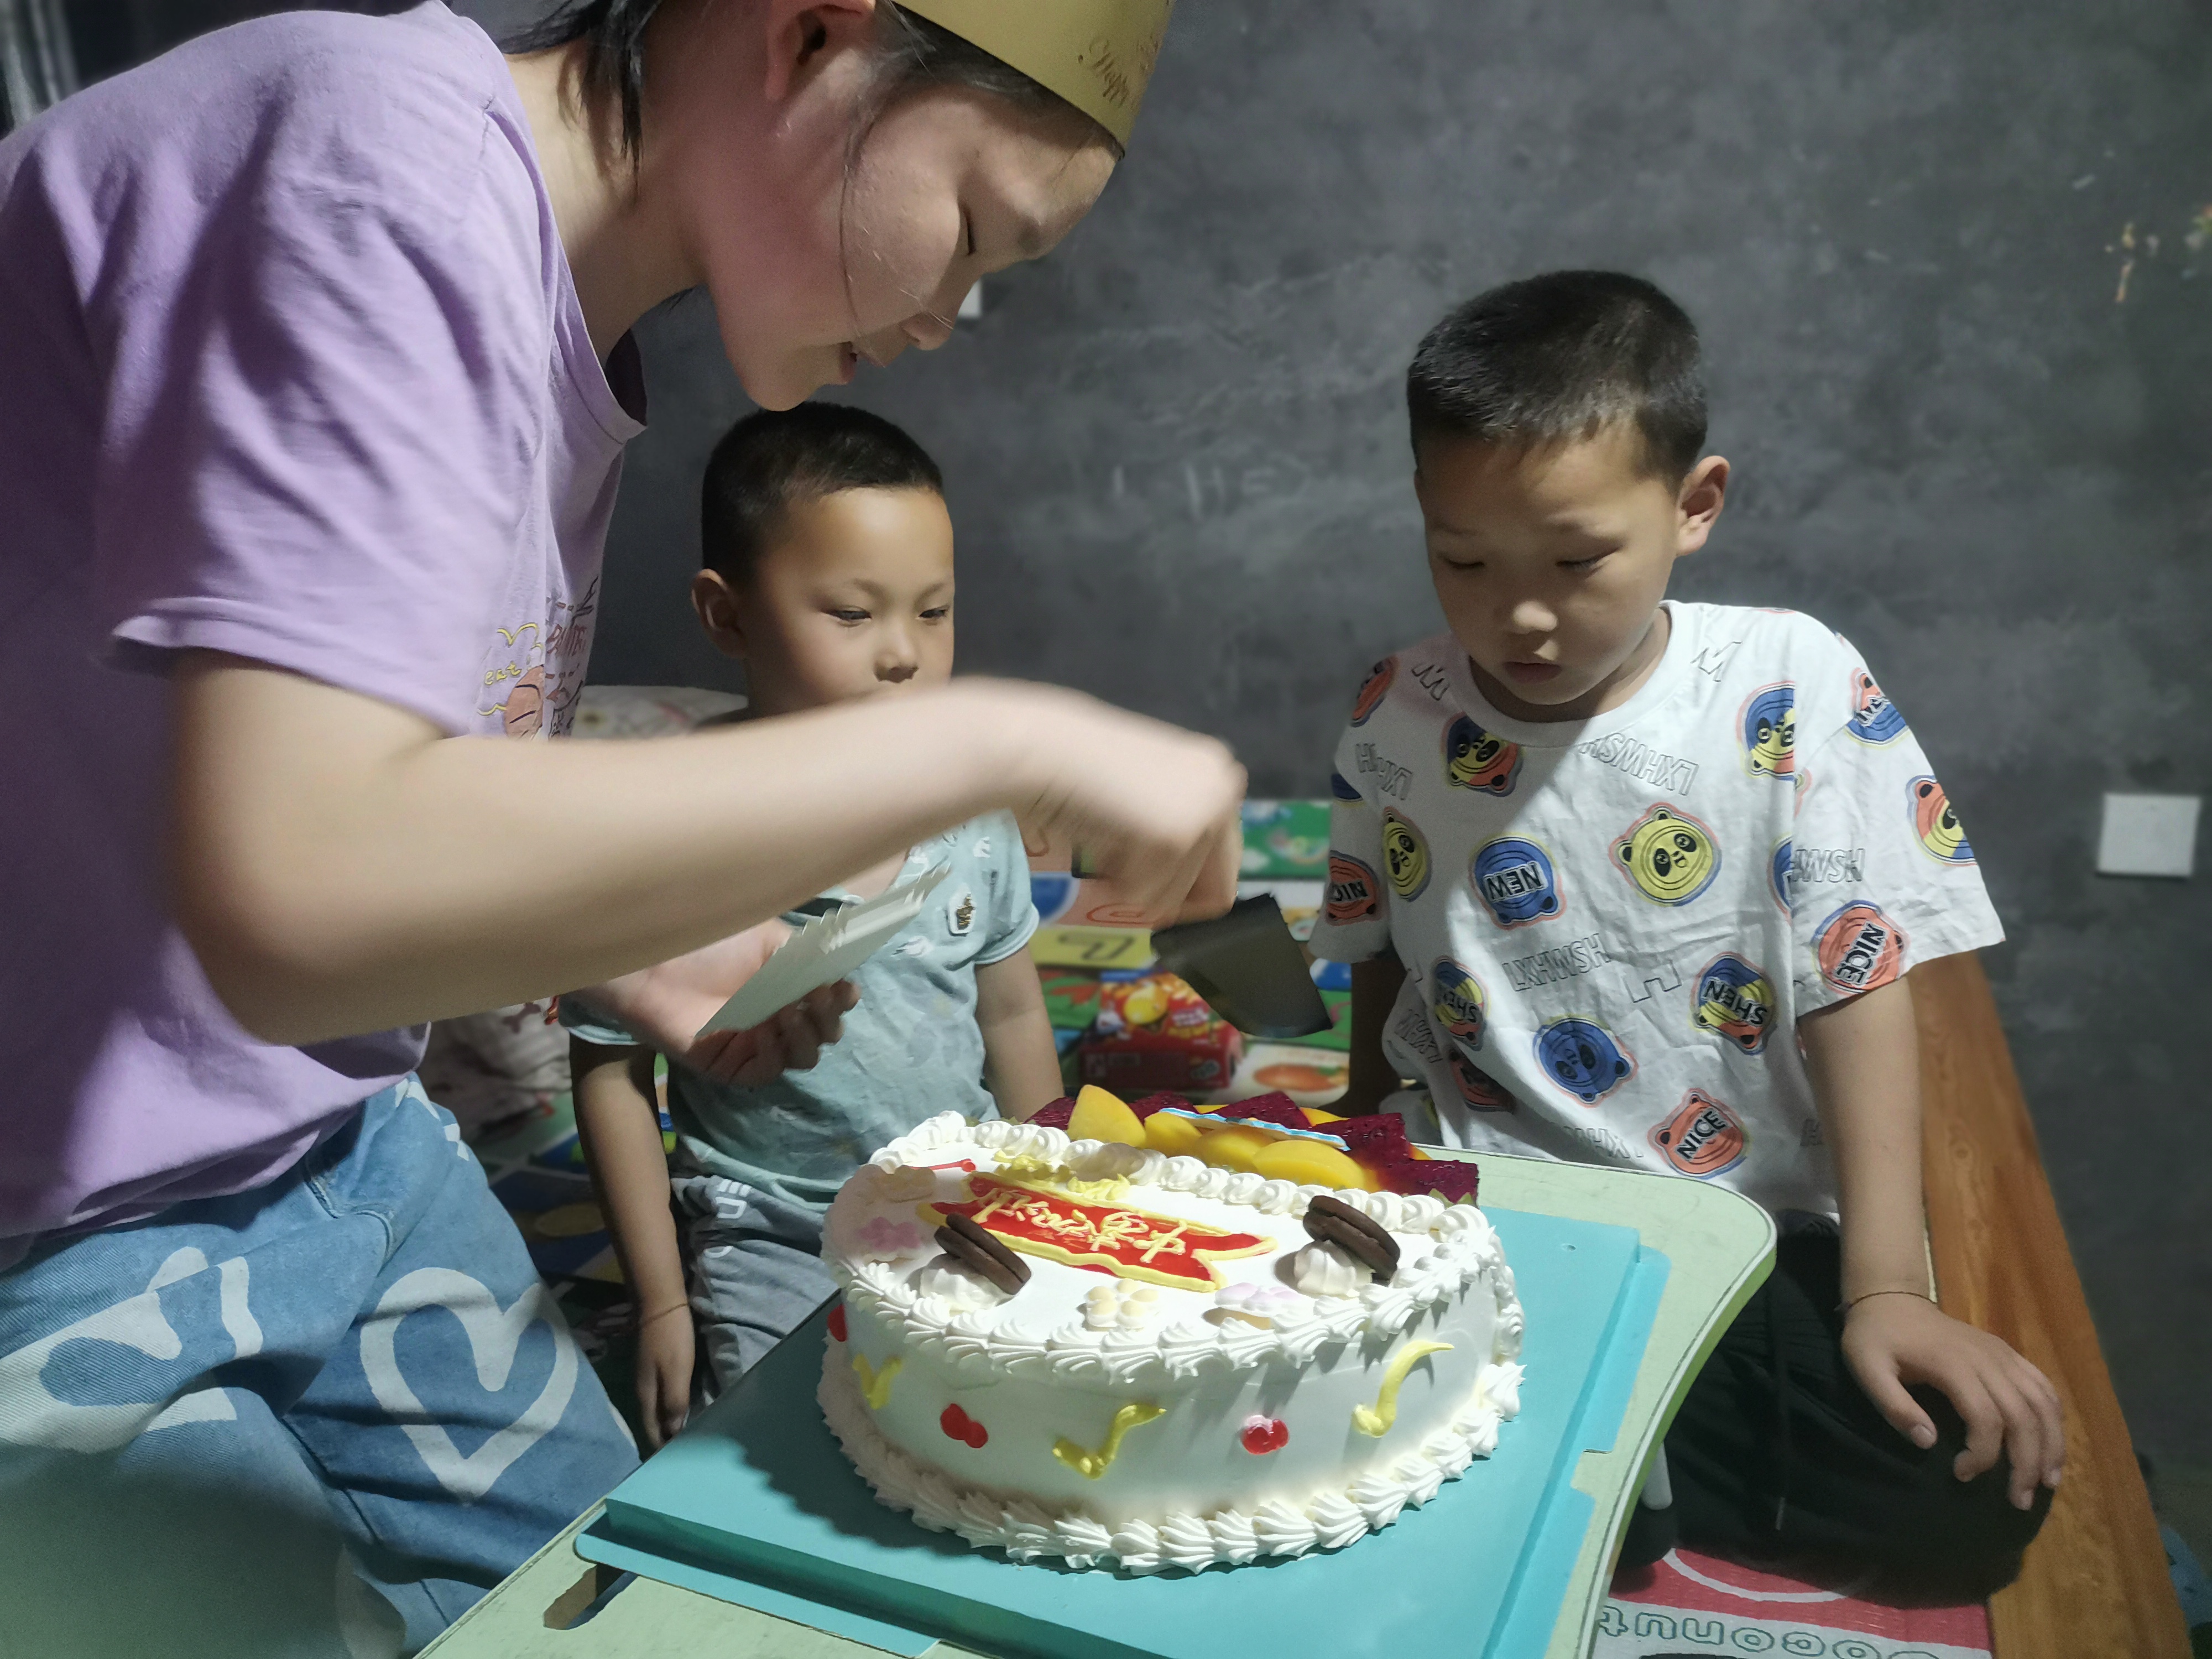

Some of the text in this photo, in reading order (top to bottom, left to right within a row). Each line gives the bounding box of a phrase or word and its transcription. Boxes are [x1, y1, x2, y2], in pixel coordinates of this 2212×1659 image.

[1485, 865, 1543, 901] NEW
[1502, 933, 1611, 992] LXHWSH
[1834, 922, 1886, 984] NICE
[1702, 979, 1768, 1026] SHEN
[1676, 1110, 1729, 1160] NICE
[1598, 1605, 1940, 1659] oconut
